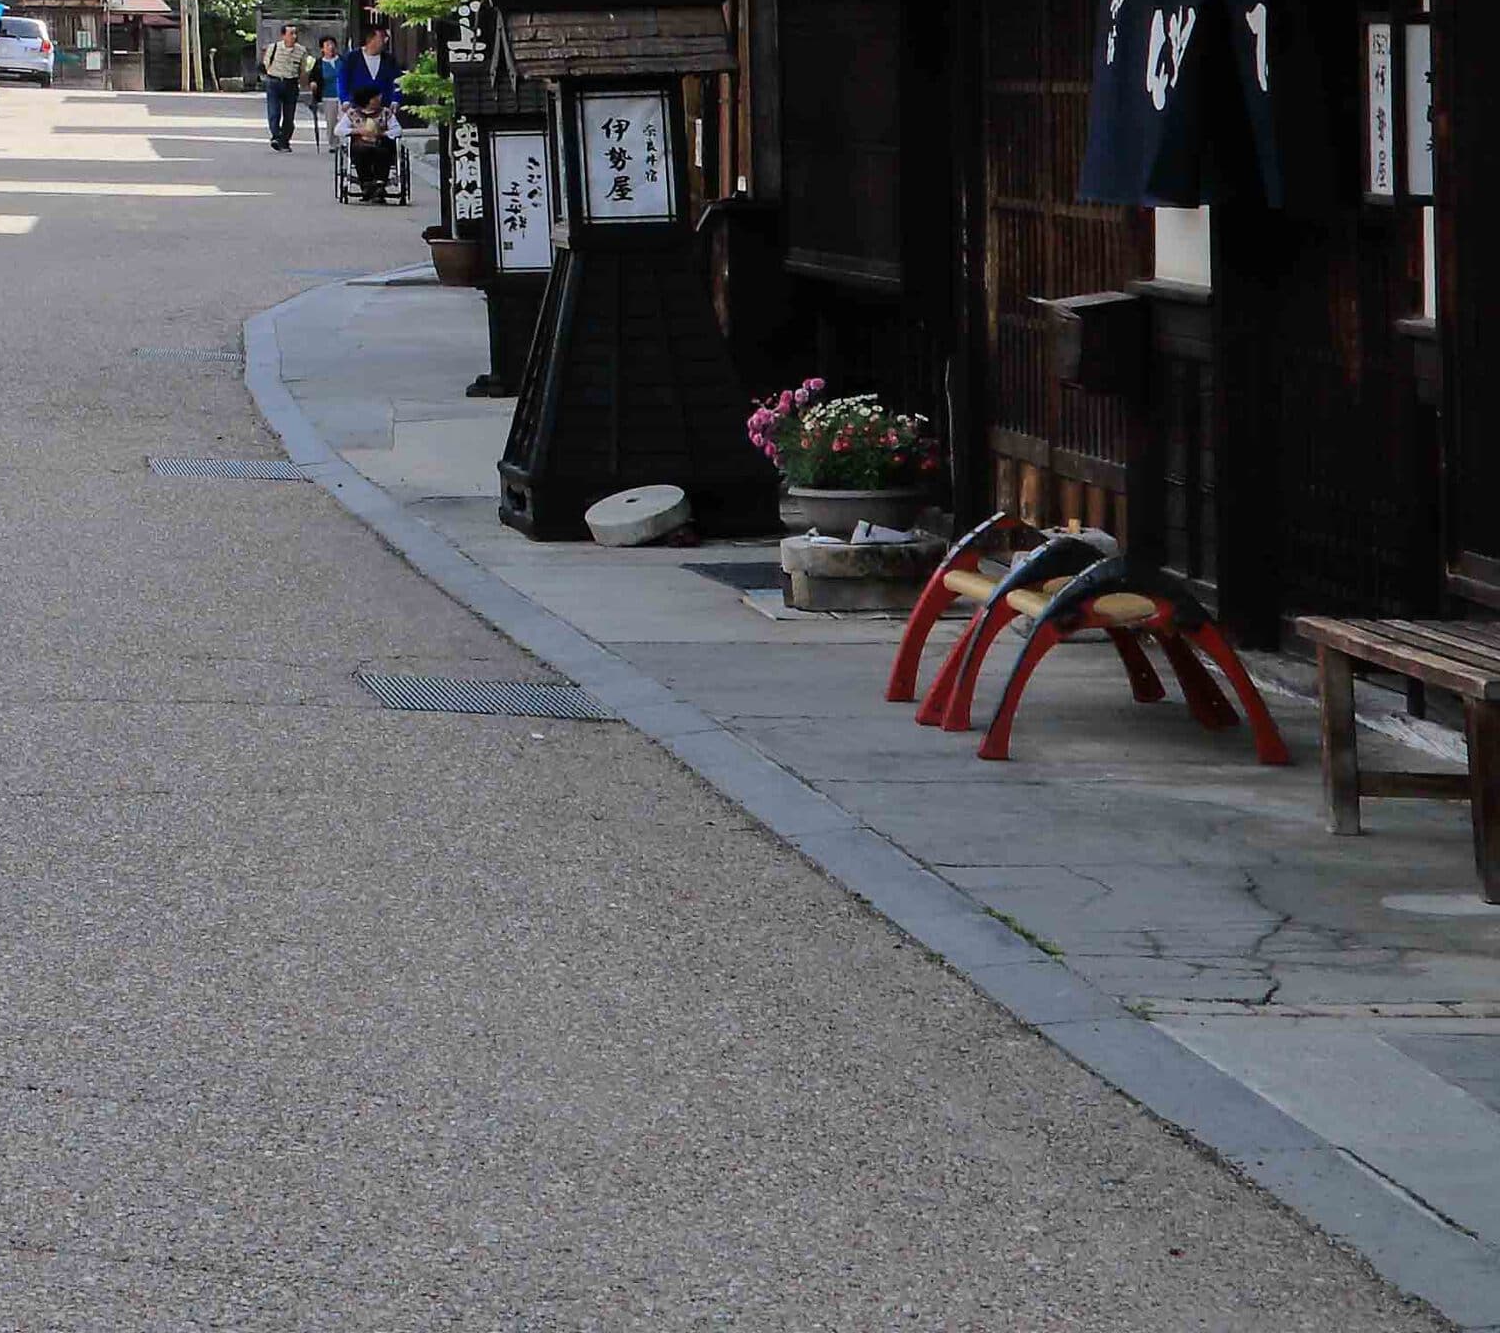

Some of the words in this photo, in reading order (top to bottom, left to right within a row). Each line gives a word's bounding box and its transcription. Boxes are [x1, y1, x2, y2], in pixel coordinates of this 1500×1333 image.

[601, 117, 634, 202] 伊勢屋
[642, 123, 659, 183] 奈良井宿
